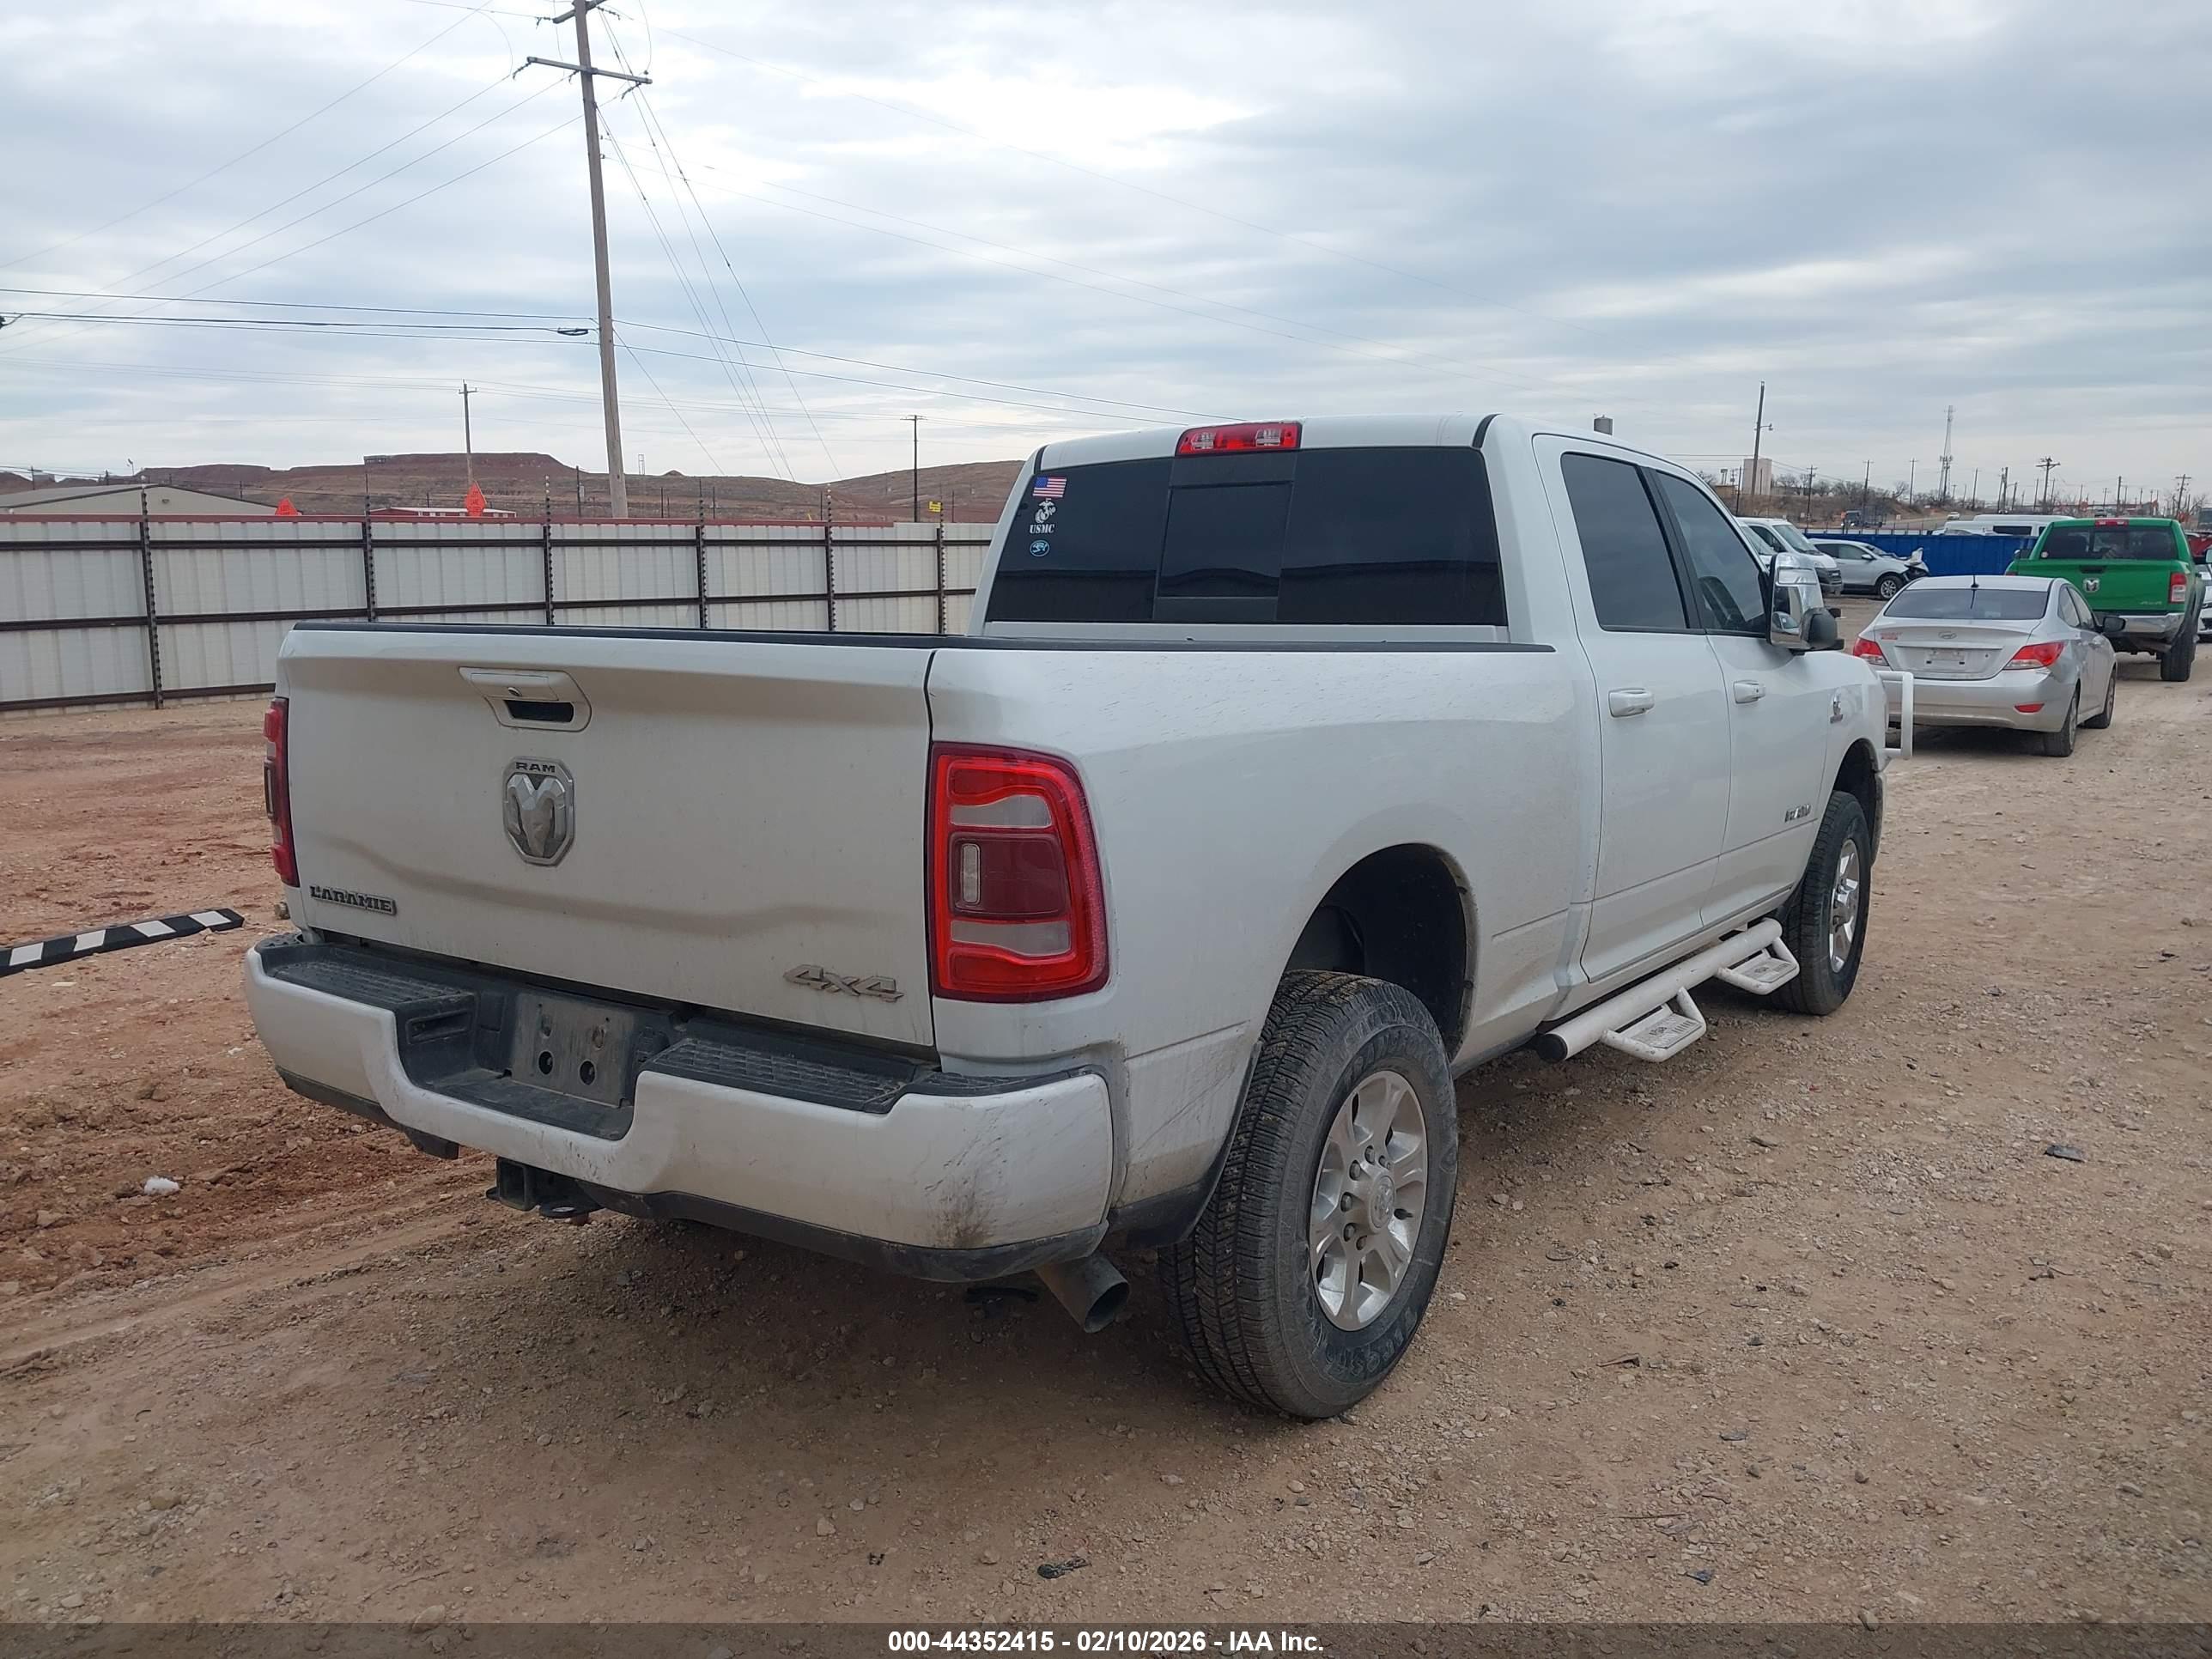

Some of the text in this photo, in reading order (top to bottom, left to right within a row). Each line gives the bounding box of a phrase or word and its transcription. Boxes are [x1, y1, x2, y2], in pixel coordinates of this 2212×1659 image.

[1030, 524, 1055, 534] USMC
[514, 762, 556, 773] RAM
[309, 886, 393, 913] LARAMIE
